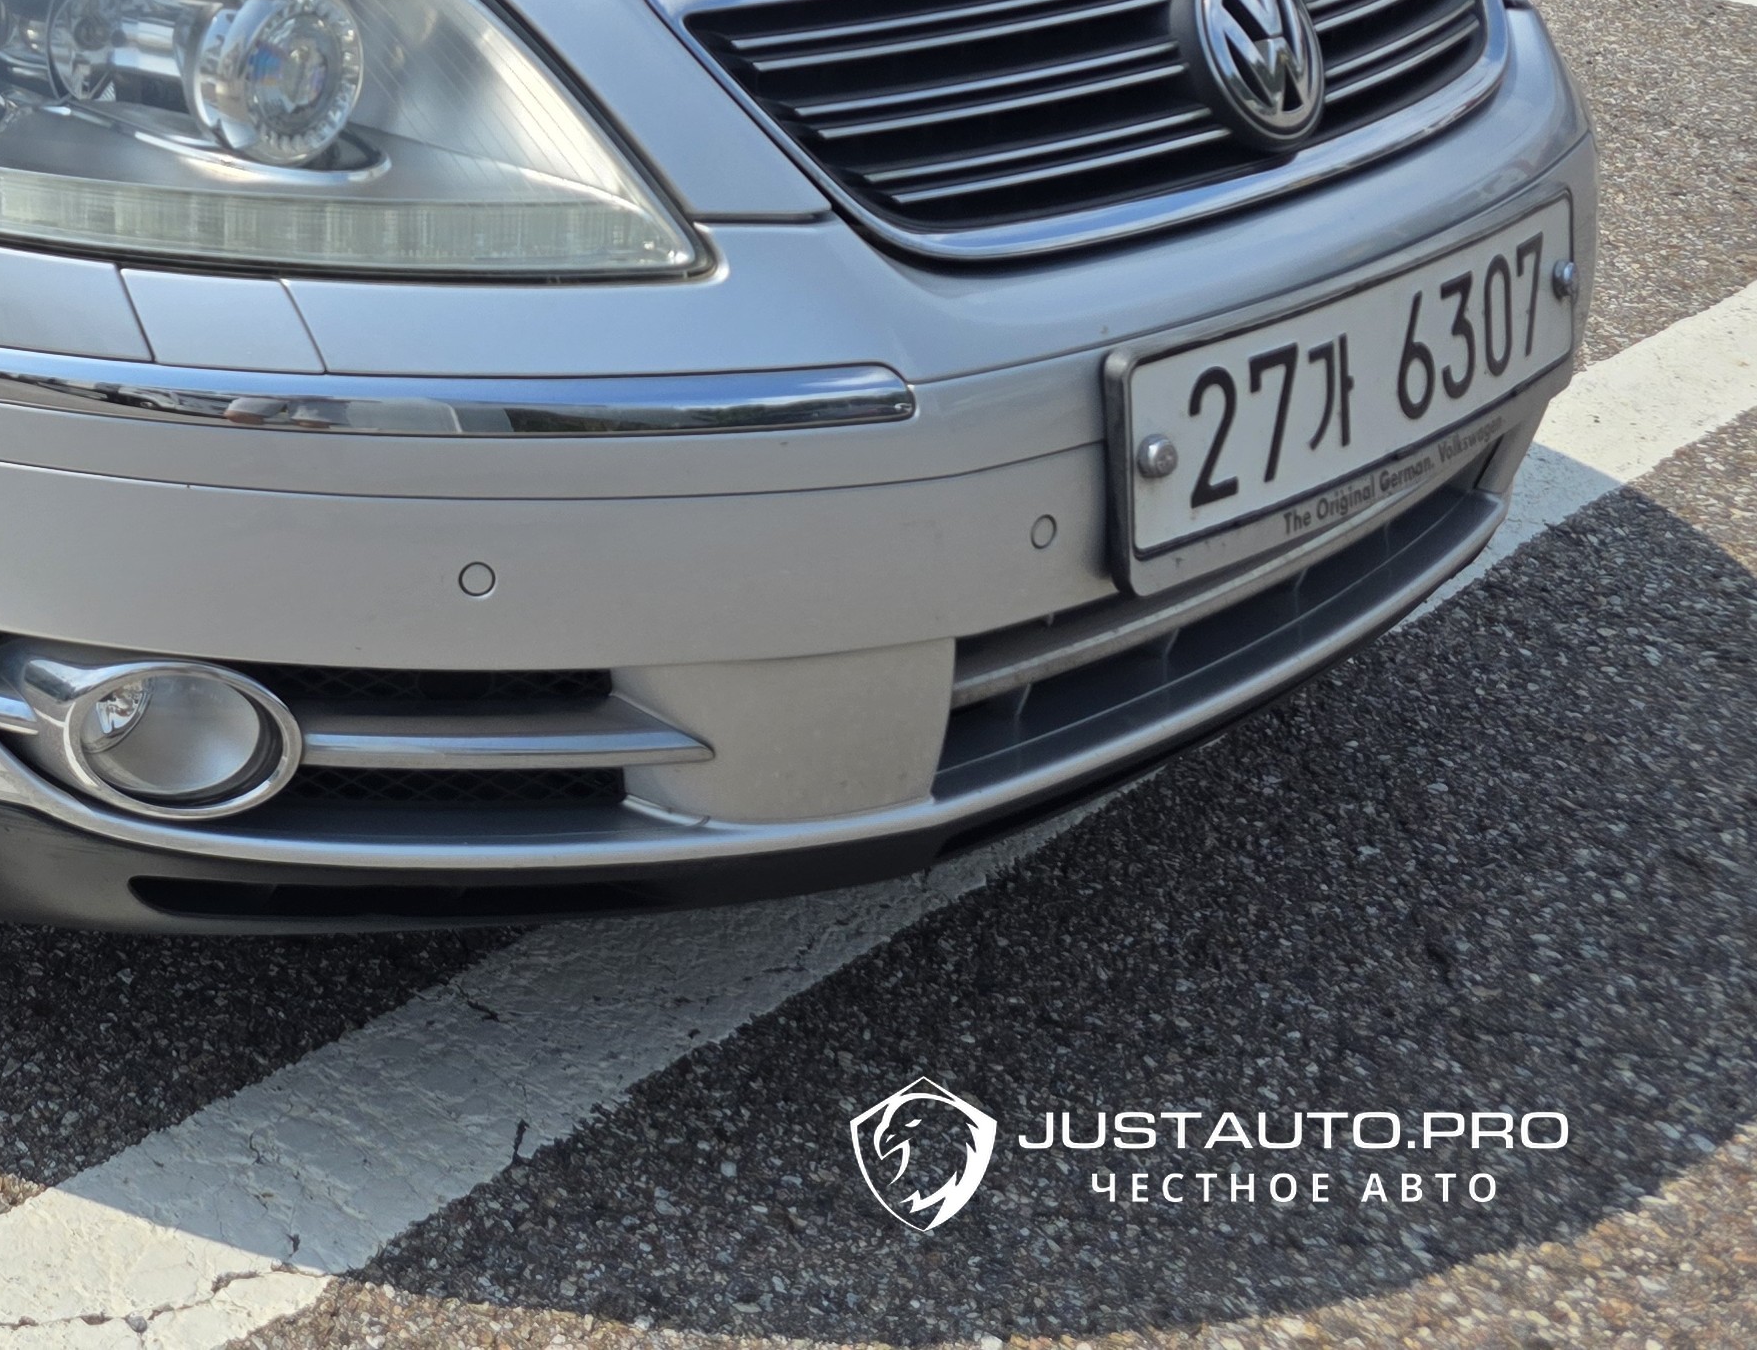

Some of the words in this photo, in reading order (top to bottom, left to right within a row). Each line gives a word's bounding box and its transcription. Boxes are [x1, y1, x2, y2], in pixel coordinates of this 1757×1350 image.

[1187, 332, 1355, 509] 27가
[1396, 230, 1544, 421] 6307
[1283, 508, 1312, 536] The
[1316, 477, 1377, 521] Original
[1378, 455, 1436, 493] German.
